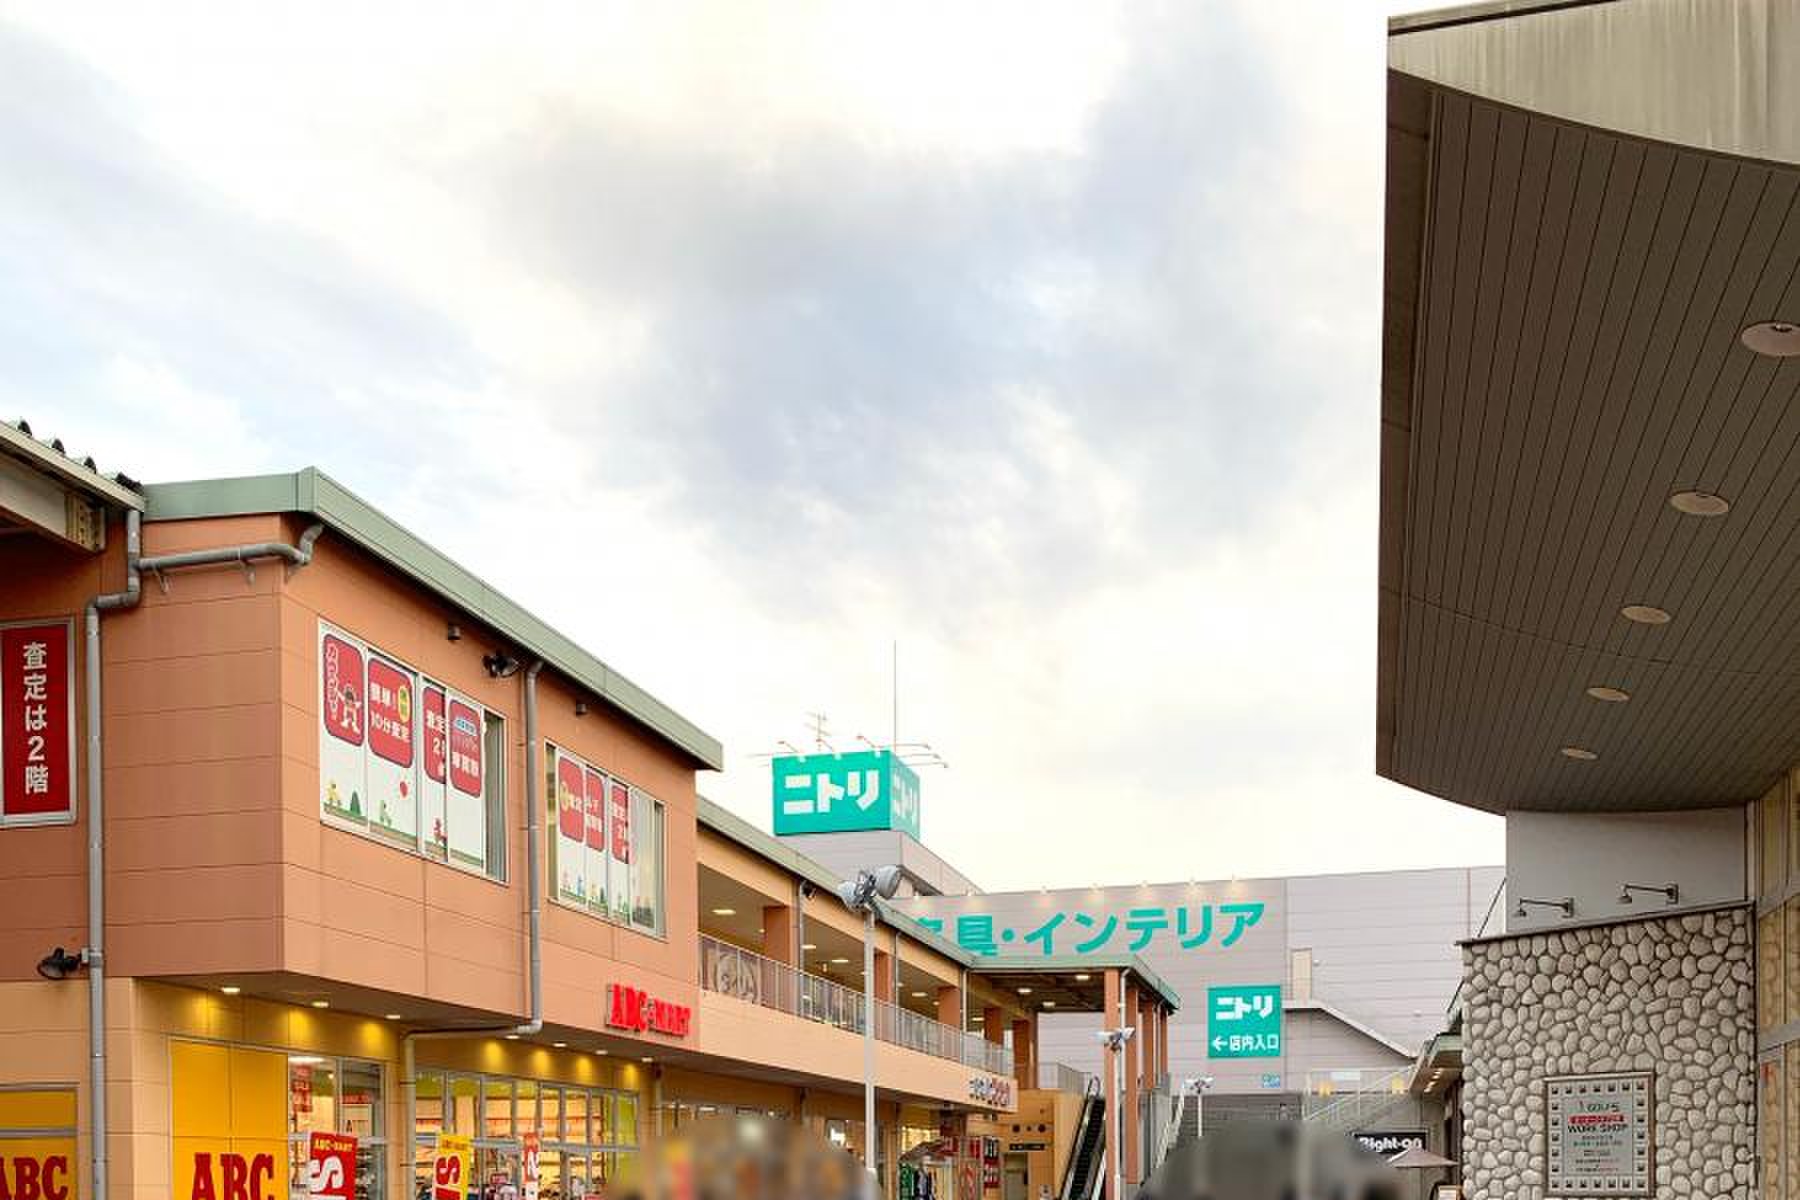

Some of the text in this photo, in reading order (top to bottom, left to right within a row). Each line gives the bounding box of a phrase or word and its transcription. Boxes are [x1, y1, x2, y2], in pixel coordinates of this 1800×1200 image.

[22, 641, 49, 795] 査定は2階
[783, 770, 880, 815] ニトリ
[918, 901, 1266, 957] 具・インテリア
[1216, 995, 1273, 1020] ニトリ
[1229, 1033, 1280, 1052] 店内入口
